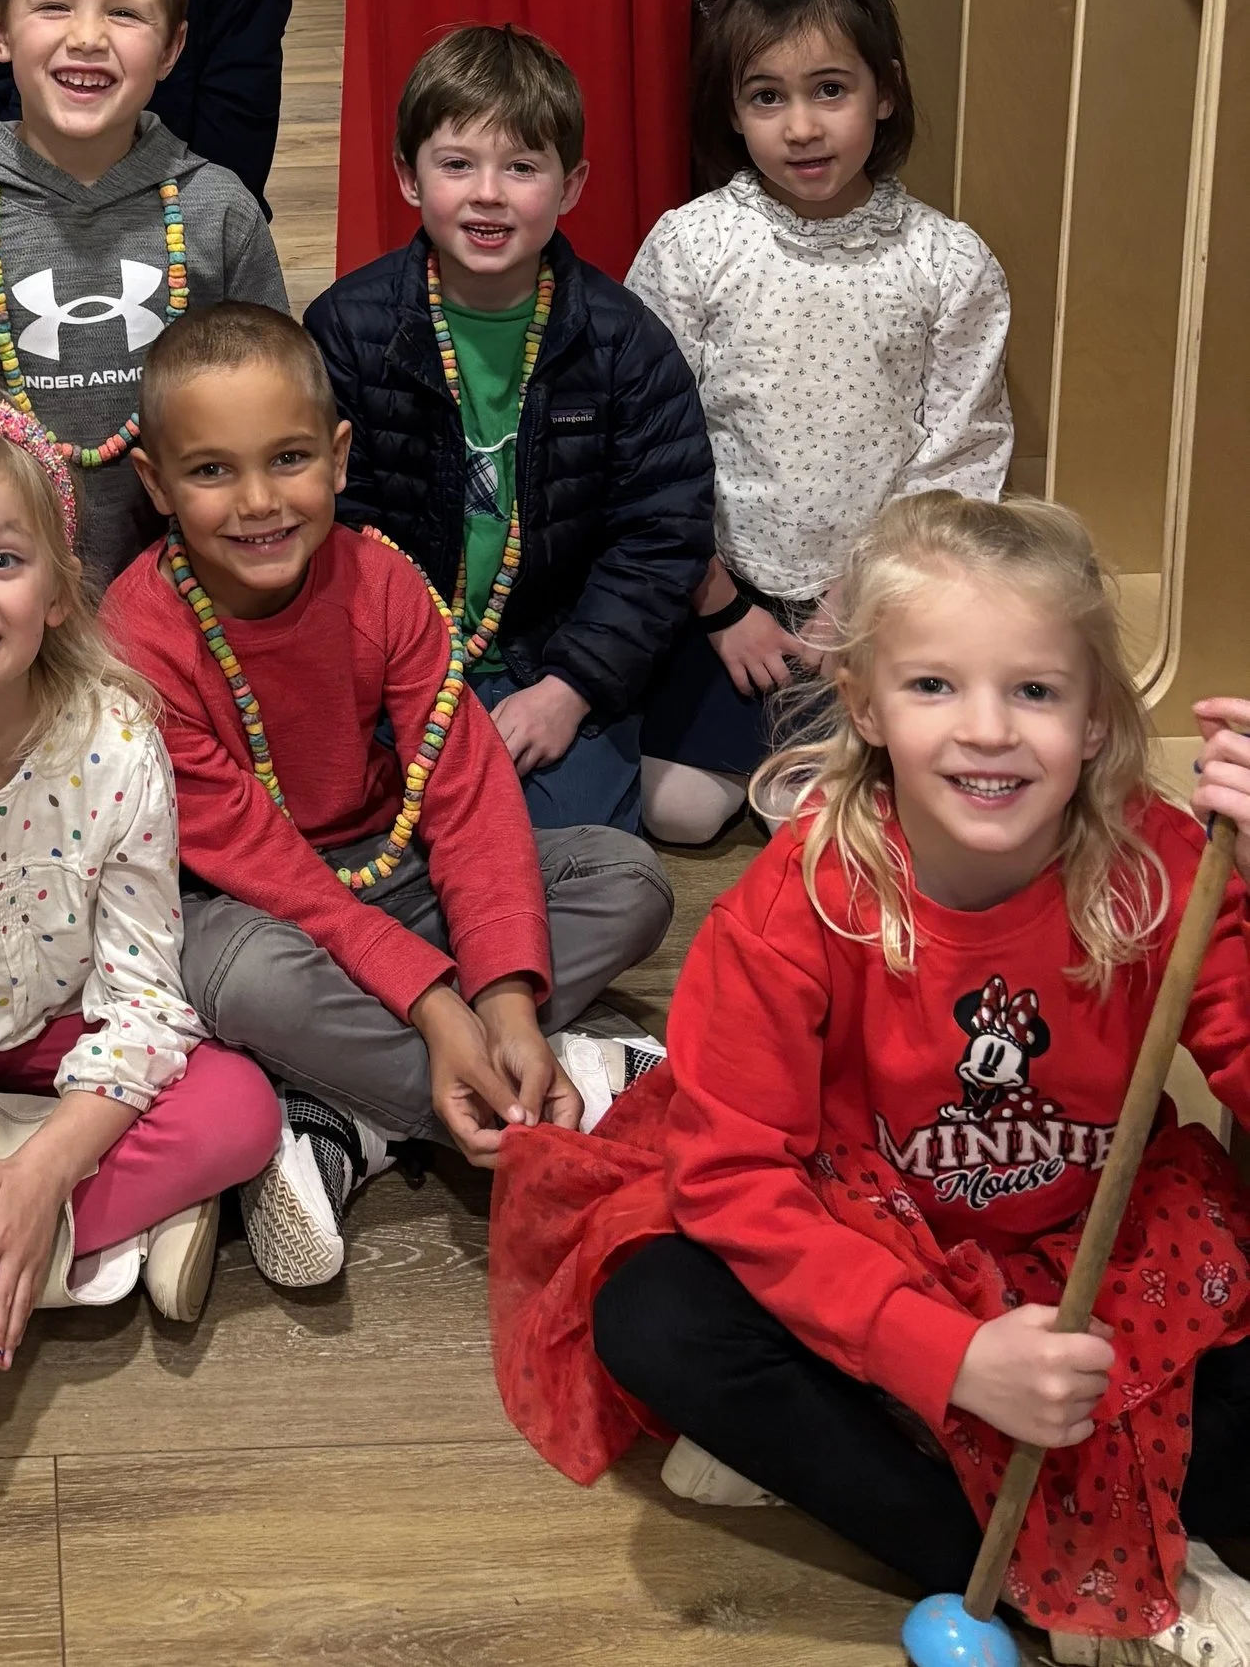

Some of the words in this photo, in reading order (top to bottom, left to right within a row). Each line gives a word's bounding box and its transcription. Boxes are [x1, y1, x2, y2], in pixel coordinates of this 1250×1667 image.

[21, 374, 84, 390] NDER
[552, 414, 593, 424] patagonia
[934, 1155, 1065, 1211] Mouse
